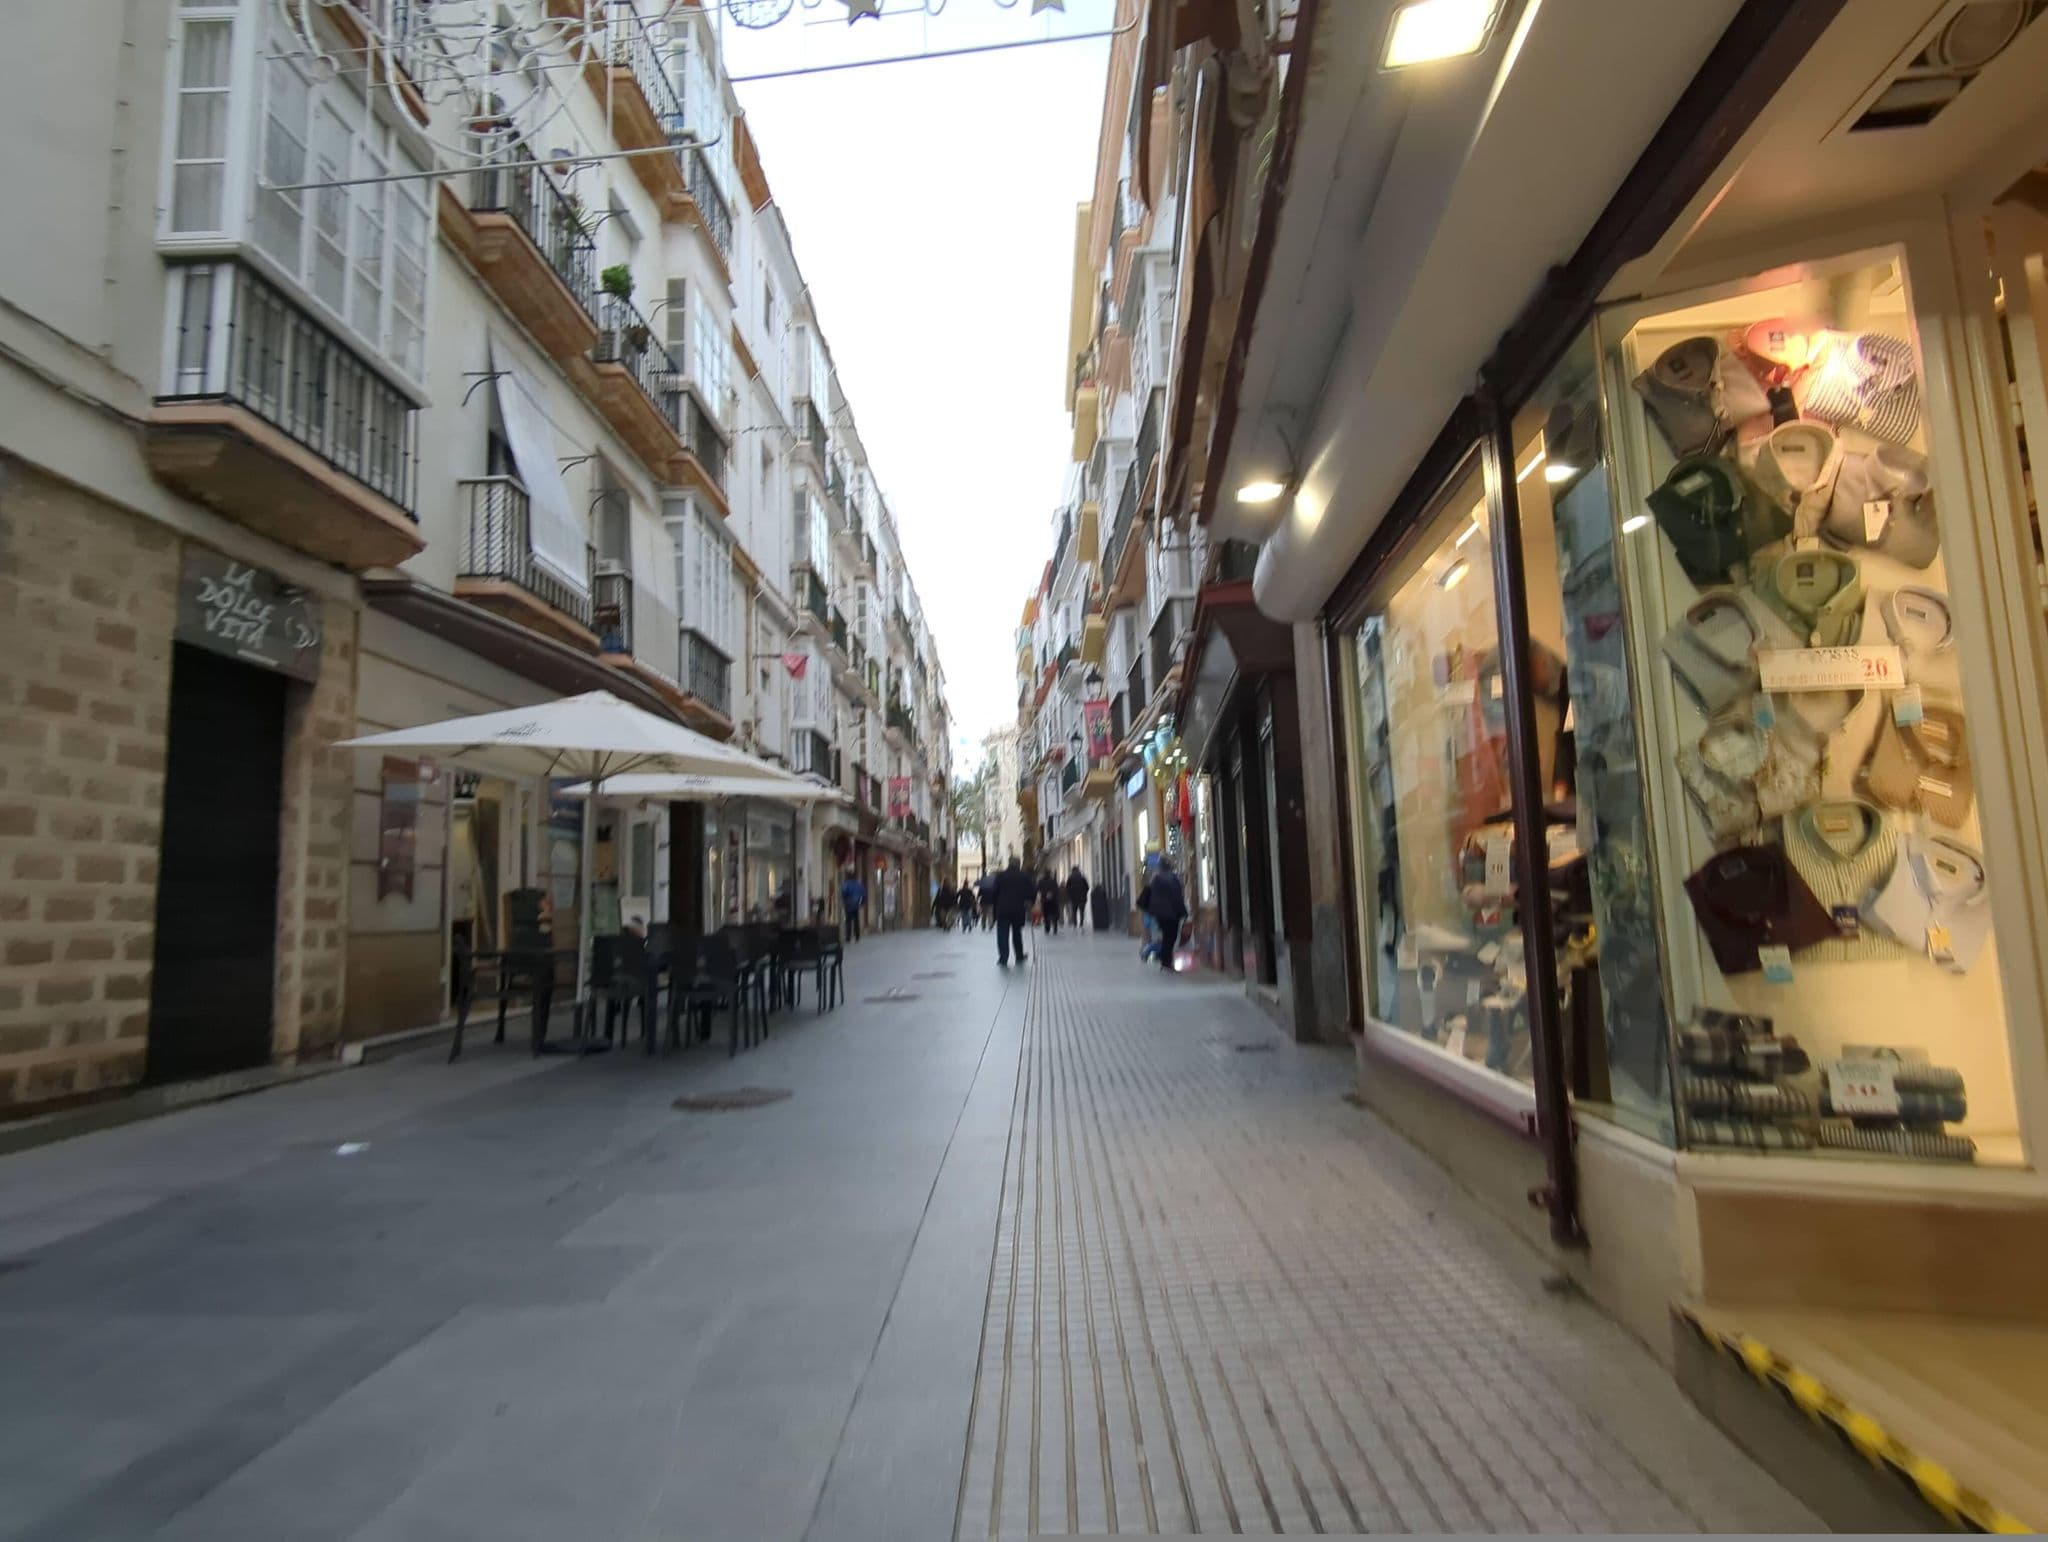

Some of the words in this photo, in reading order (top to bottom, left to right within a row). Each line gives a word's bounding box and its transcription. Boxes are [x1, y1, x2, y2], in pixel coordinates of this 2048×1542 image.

[222, 562, 256, 592] LA
[196, 577, 275, 622] DOLCE
[206, 609, 272, 649] VITA
